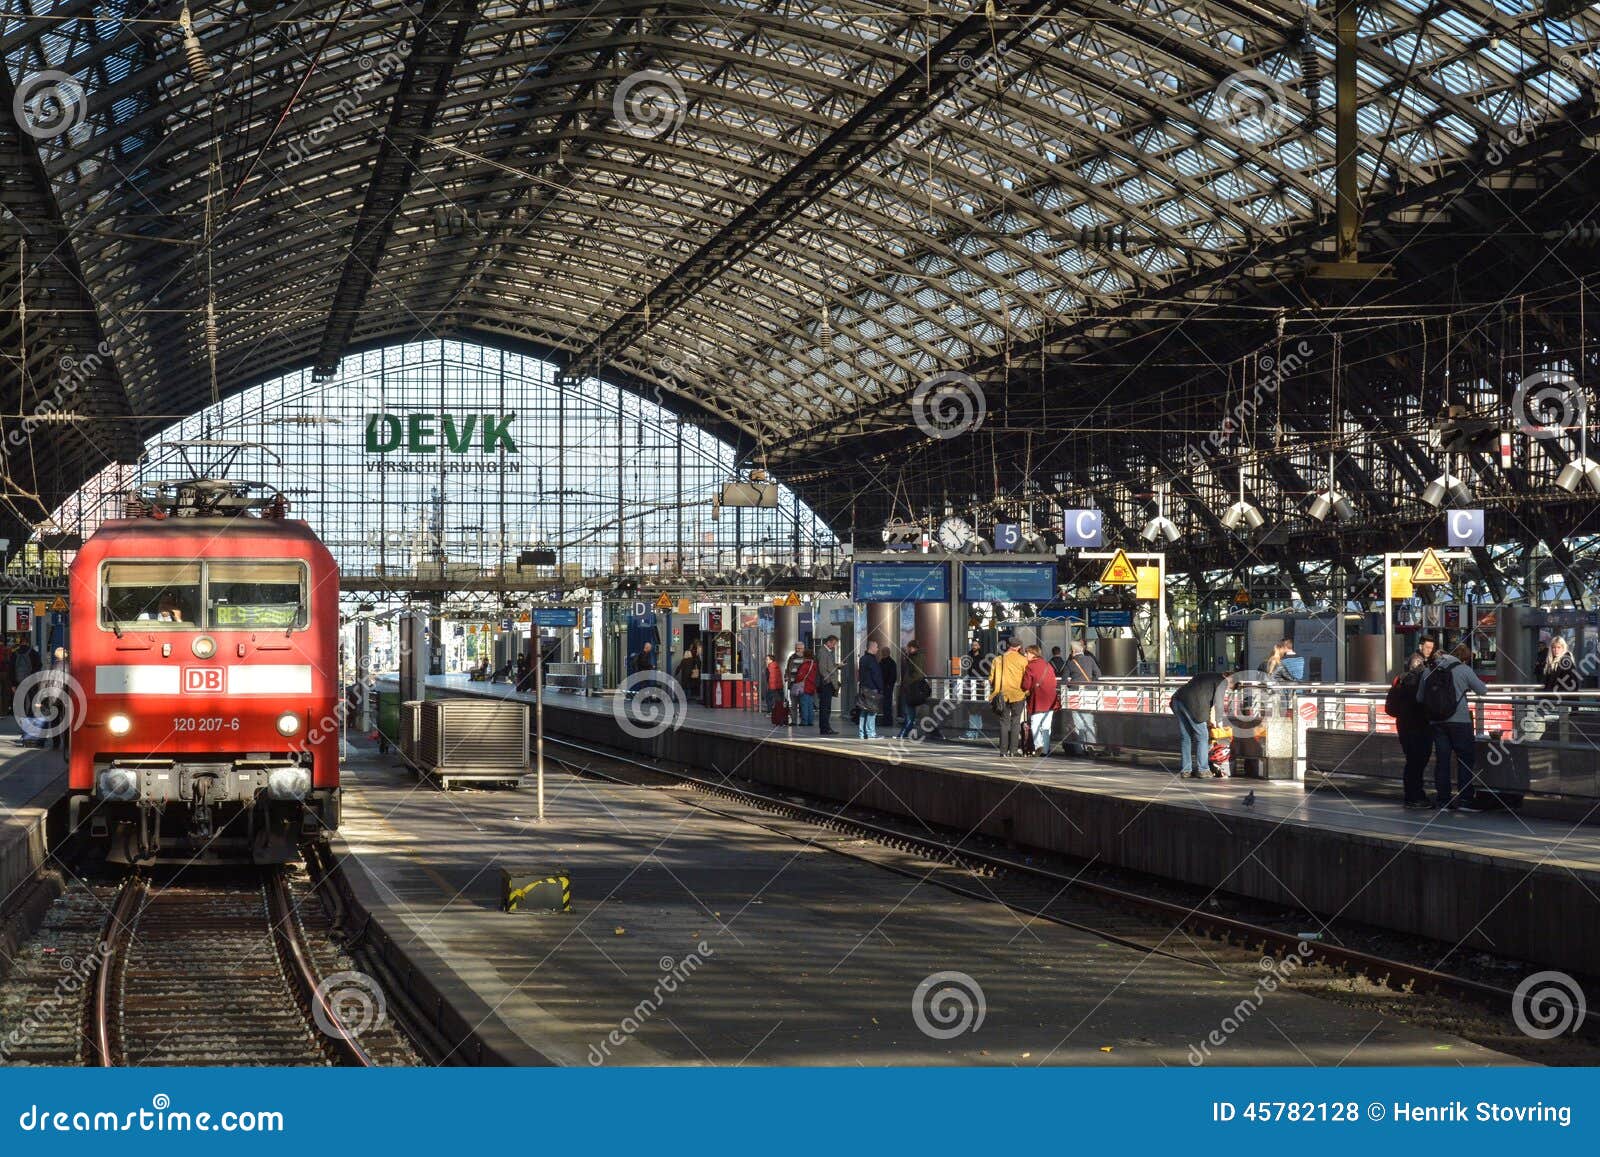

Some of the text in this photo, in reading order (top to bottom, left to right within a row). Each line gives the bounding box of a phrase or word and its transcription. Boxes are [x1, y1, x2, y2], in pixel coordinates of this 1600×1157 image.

[365, 413, 520, 453] DEVK
[366, 461, 520, 473] VERSICHERUNGEN
[1076, 510, 1097, 539] C
[1453, 510, 1473, 538] C
[1005, 525, 1018, 544] 5
[1044, 569, 1051, 579] 5
[635, 602, 646, 616] D
[501, 619, 509, 629] E
[188, 670, 220, 689] DB
[173, 717, 240, 731] 120 207-6
